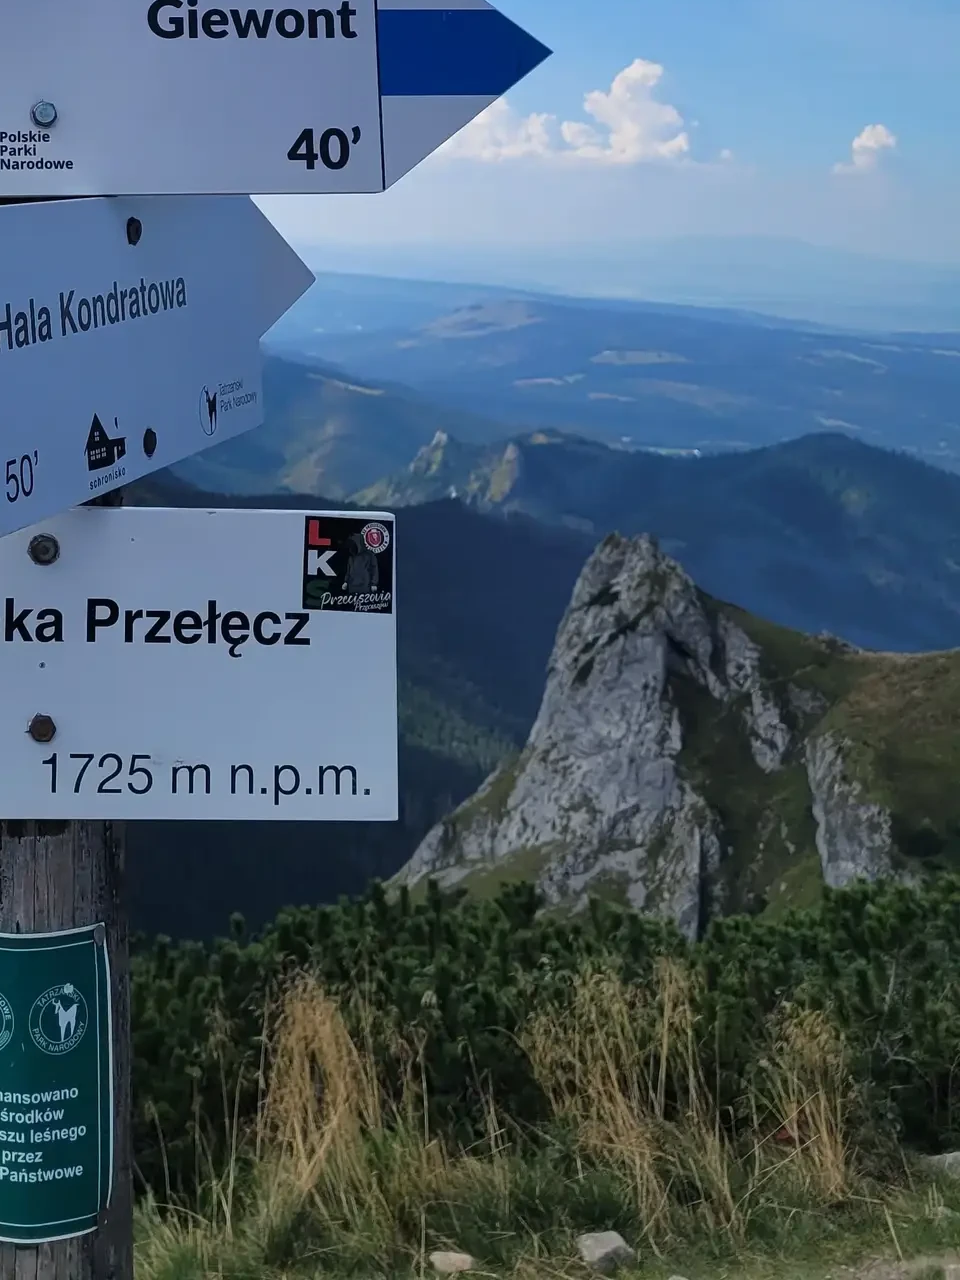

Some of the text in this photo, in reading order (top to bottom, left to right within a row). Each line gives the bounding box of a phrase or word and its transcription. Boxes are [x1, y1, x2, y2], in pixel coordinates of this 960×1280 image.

[0, 130, 51, 144] Polskie
[286, 126, 362, 170] 40'
[0, 144, 37, 157] Parki
[0, 157, 74, 171] Narodowe
[59, 276, 187, 337] Kondratowa
[5, 449, 38, 503] 50'
[89, 466, 126, 490] schronisko
[86, 598, 311, 658] Przełęcz
[42, 752, 371, 806] 1725 m n.p.m.
[36, 986, 80, 1007] TATRZASKI
[0, 1106, 65, 1124] środków
[30, 1122, 87, 1144] leśnego
[1, 1149, 43, 1165] przez
[0, 1162, 84, 1184] Państwowe
